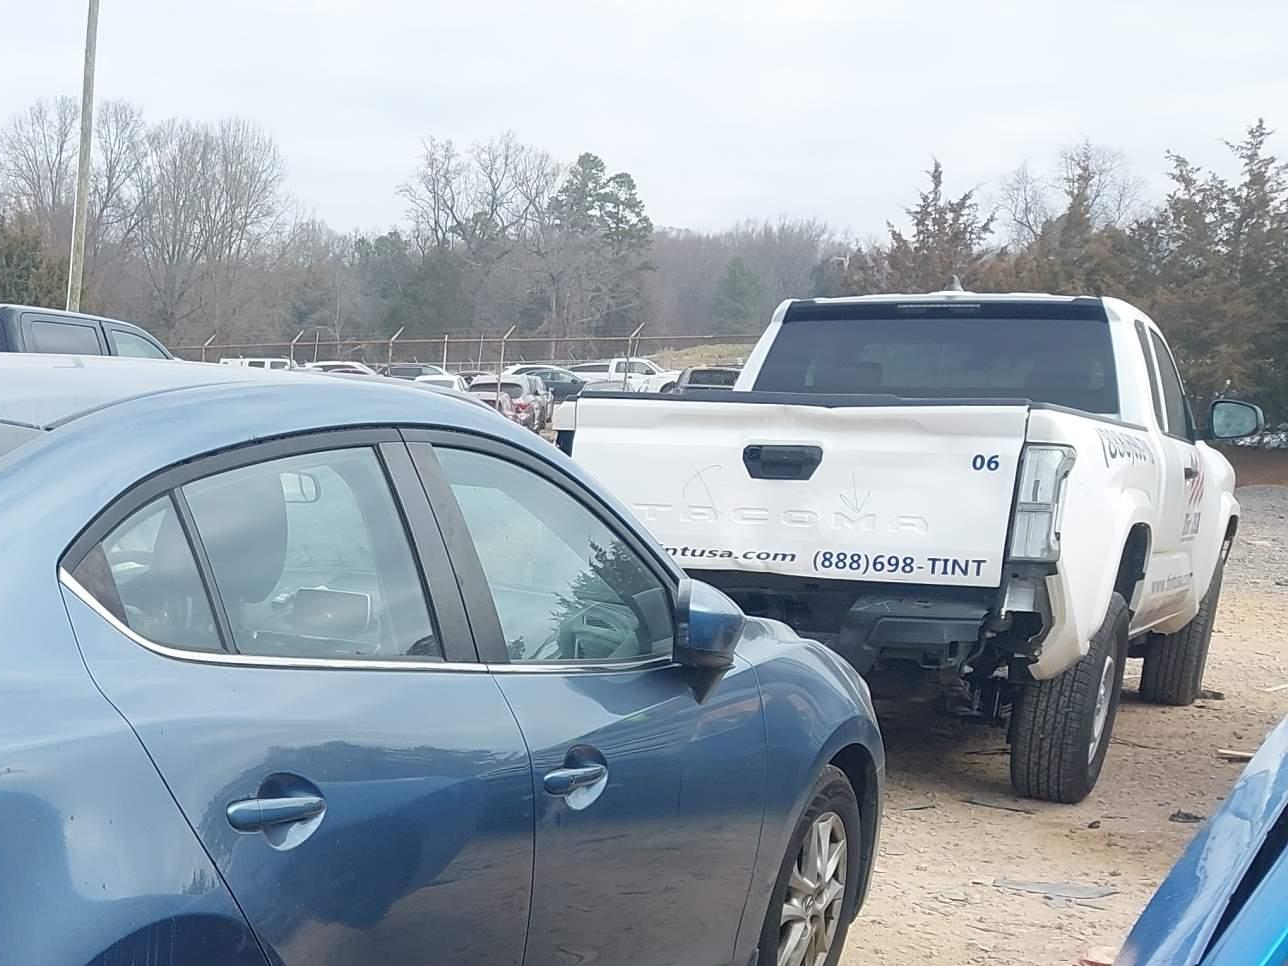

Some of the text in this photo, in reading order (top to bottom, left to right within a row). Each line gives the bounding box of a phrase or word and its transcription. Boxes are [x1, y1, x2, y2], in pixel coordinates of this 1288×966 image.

[972, 454, 1000, 471] 06
[632, 502, 929, 534] TACOMA
[659, 544, 987, 576] ntusa.com (888)698-TINT
